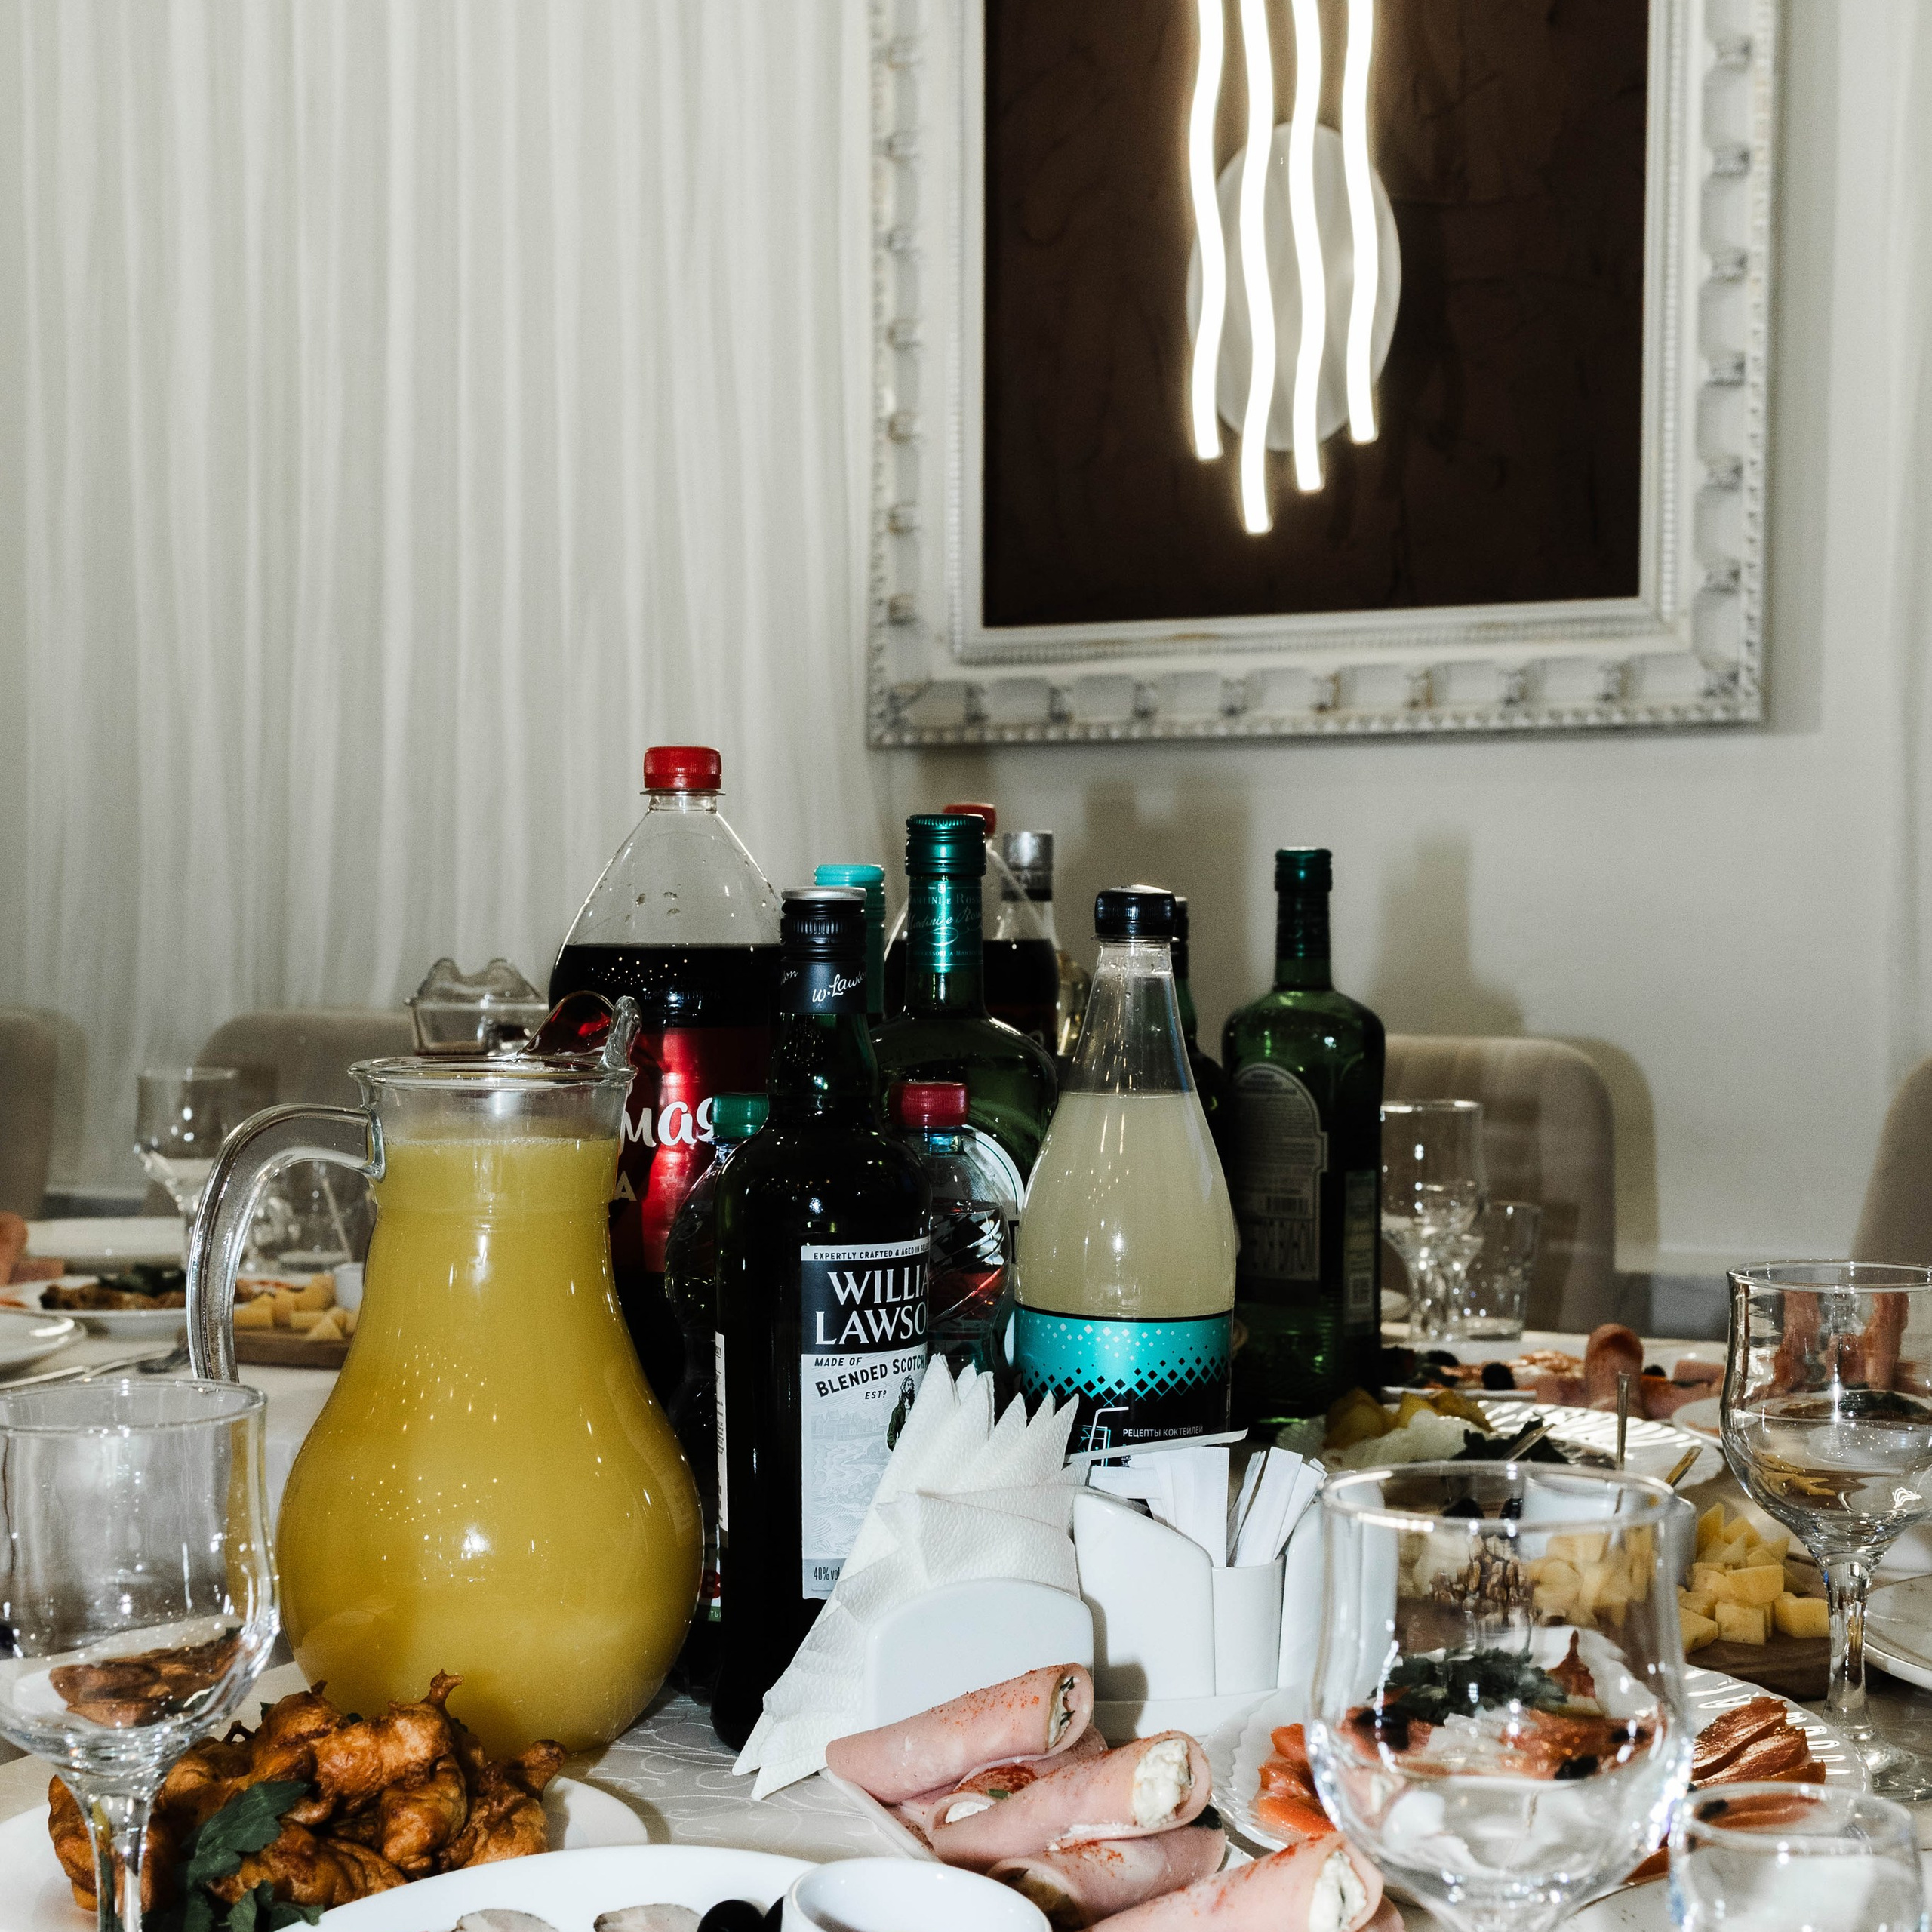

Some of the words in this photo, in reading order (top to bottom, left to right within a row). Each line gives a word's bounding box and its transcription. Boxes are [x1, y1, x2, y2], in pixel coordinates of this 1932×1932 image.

[814, 1252, 857, 1260] EXPERTLY
[859, 1251, 893, 1259] CRAFTED
[827, 1263, 929, 1306] WILLIA
[815, 1302, 927, 1345] LAWSO
[814, 1358, 844, 1367] MADE
[849, 1357, 863, 1366] OF
[815, 1363, 888, 1398] BLENDED
[1122, 1429, 1161, 1438] РЕЦЕПТЫ
[1163, 1424, 1204, 1437] КОКТЕЙЛЕЙ
[814, 1567, 830, 1580] 40%
